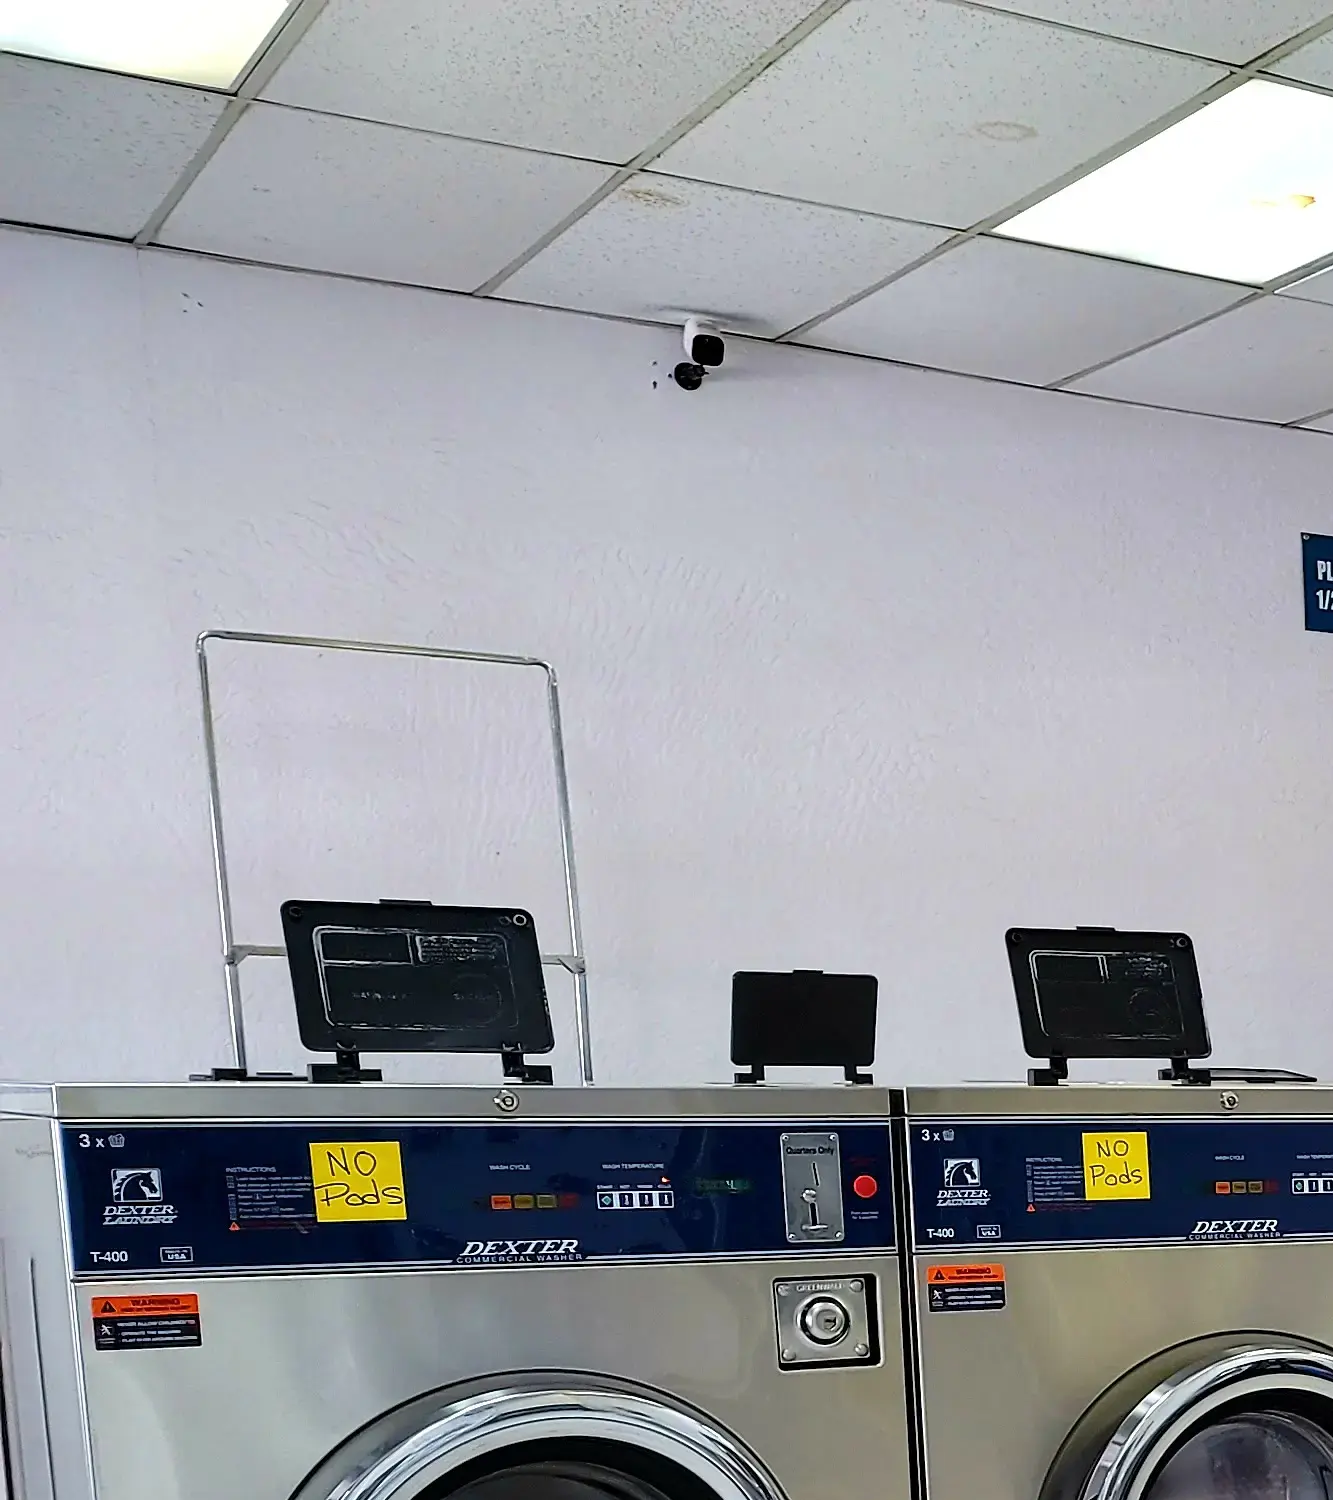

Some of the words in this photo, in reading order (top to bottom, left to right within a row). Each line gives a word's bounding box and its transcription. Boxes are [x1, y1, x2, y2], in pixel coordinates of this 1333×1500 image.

[79, 1134, 90, 1148] 3
[95, 1137, 105, 1148] x
[922, 1129, 930, 1141] 3
[933, 1132, 940, 1141] x
[786, 1146, 817, 1155] Quarters
[818, 1146, 834, 1155] Only
[1096, 1140, 1129, 1157] NO
[326, 1147, 377, 1177] NO
[1089, 1162, 1142, 1186] Pods
[314, 1178, 403, 1206] Pods
[936, 1189, 988, 1199] DEXTER
[936, 1198, 991, 1206] LAUNDRY
[102, 1204, 175, 1216] DEXTER
[102, 1215, 178, 1225] LAUNDRY
[1191, 1220, 1278, 1233] DEXTER
[927, 1228, 954, 1238] T-400
[1246, 1231, 1281, 1239] WASHER
[460, 1239, 579, 1256] DEXTER
[90, 1250, 129, 1263] T-400
[456, 1255, 531, 1264] COMMERCIAL
[536, 1253, 582, 1262] WASHER
